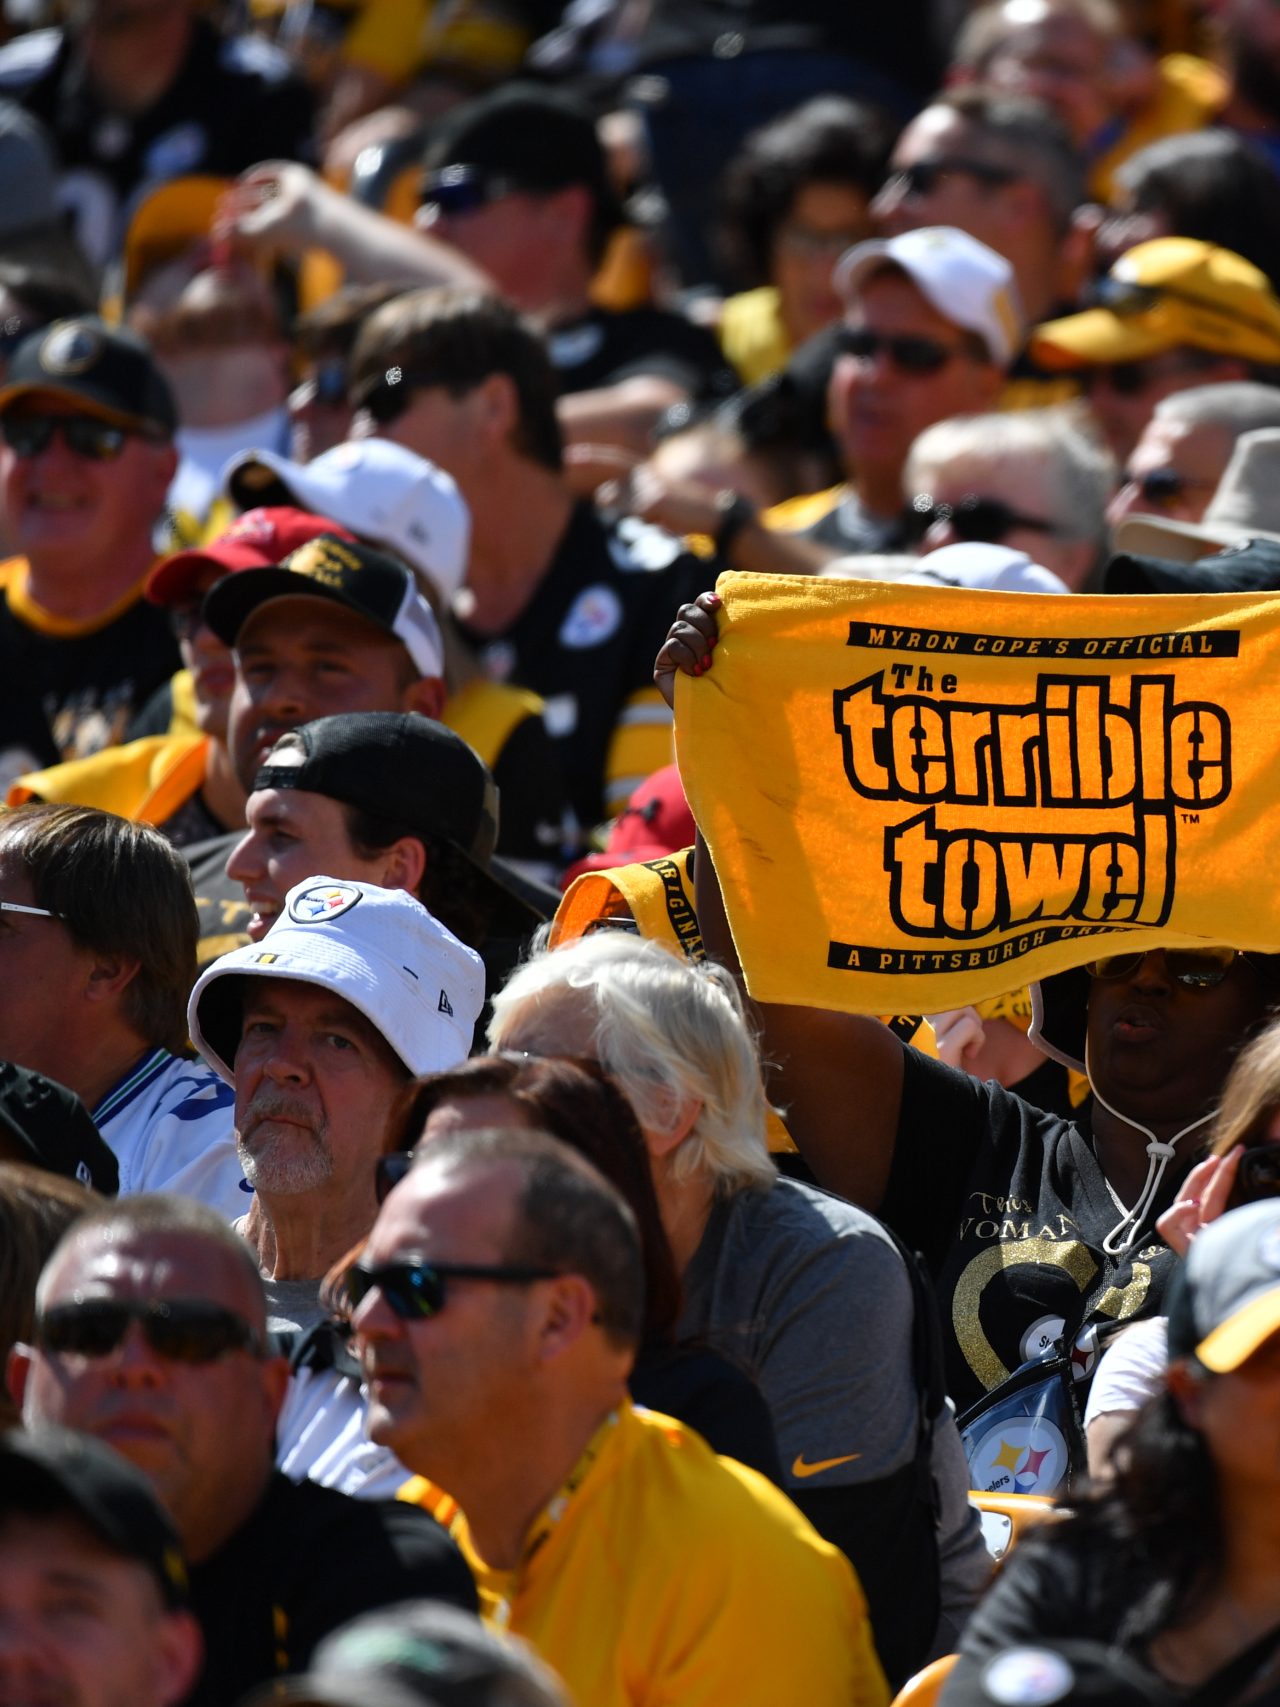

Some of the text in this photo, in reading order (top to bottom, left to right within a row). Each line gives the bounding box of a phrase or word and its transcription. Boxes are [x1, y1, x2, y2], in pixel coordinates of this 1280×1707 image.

[868, 628, 1214, 655] MYRON COPE'S OFFICIAL
[890, 663, 958, 694] The
[832, 670, 1232, 810] terrible
[884, 805, 1176, 939] towel
[847, 949, 861, 967] A
[879, 930, 1047, 971] PITTSBURGH
